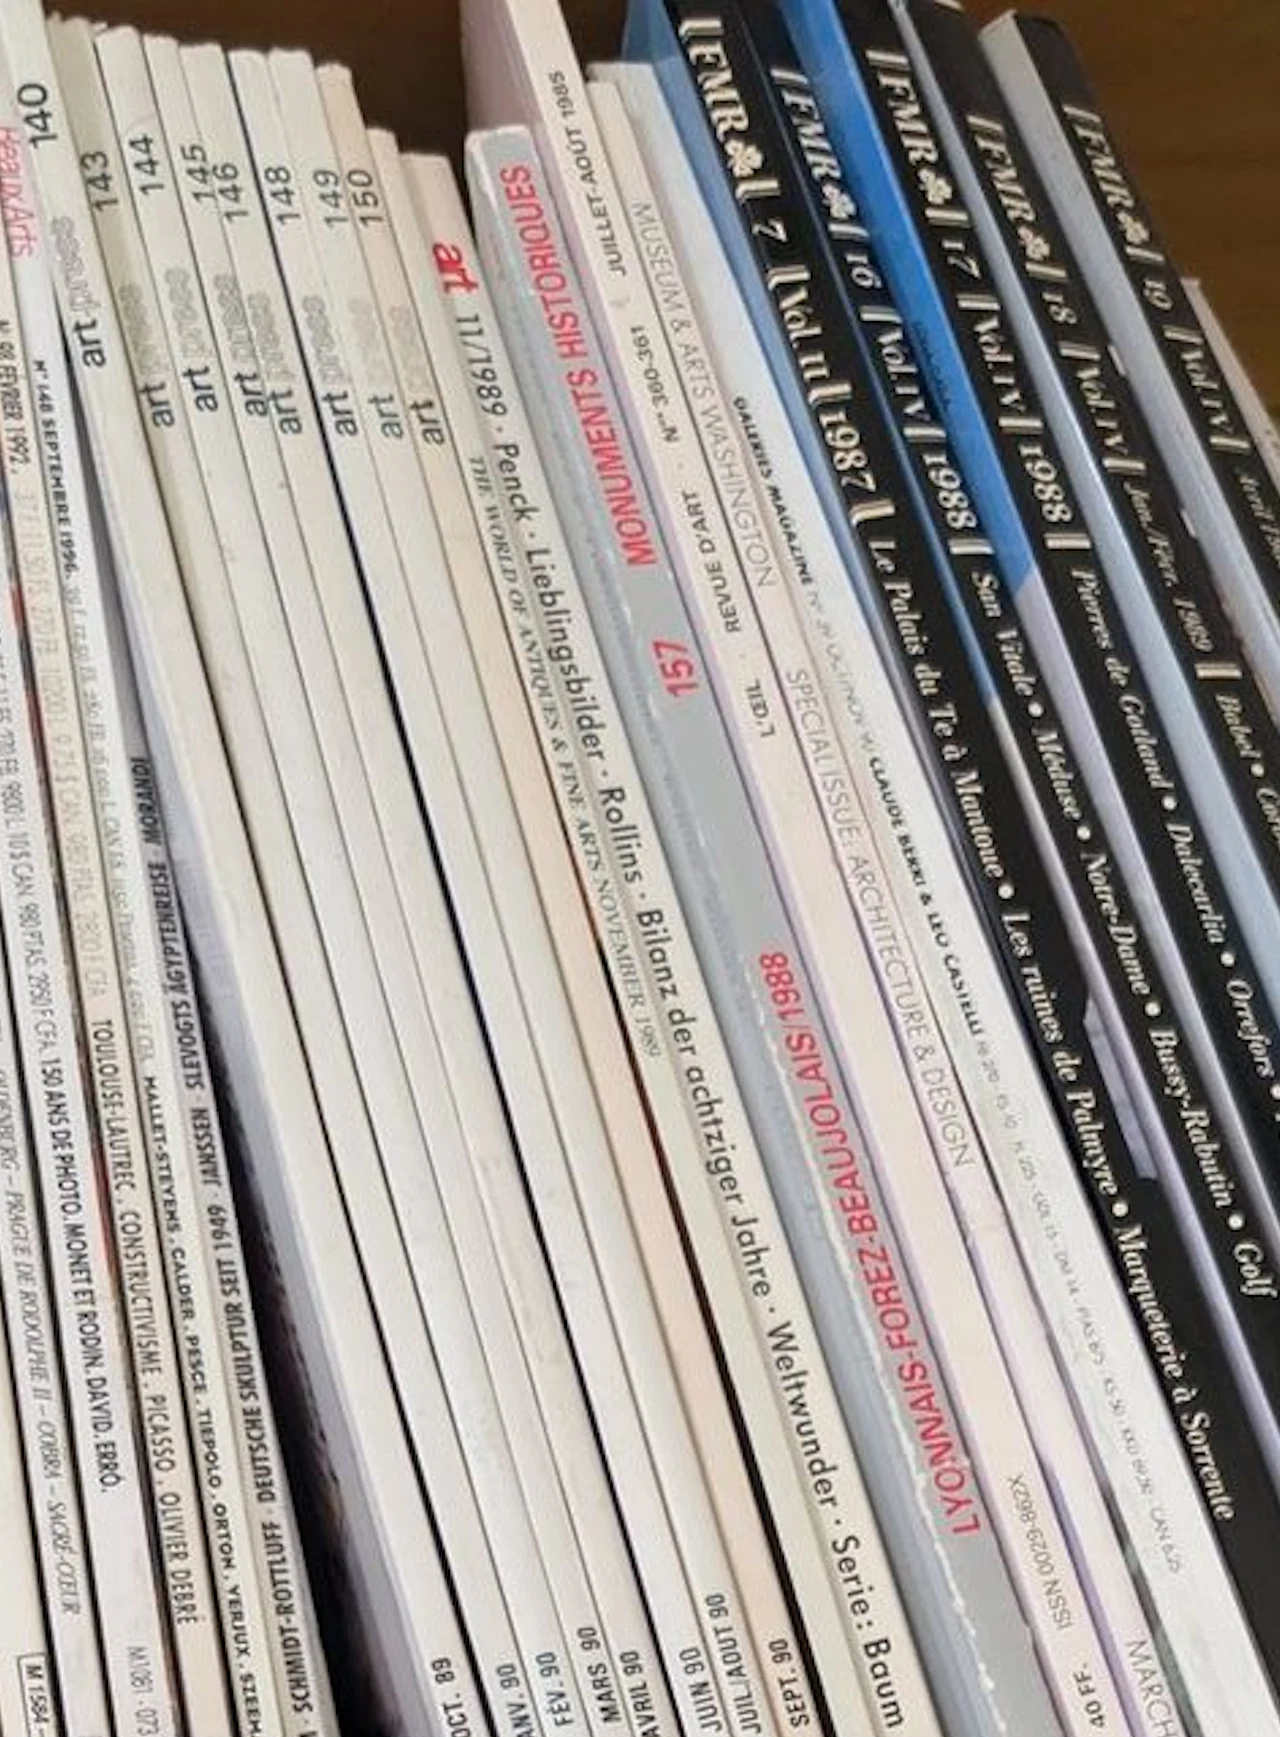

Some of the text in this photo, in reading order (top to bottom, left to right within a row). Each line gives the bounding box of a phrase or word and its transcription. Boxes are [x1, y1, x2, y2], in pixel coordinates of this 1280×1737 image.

[15, 82, 58, 149] 140
[689, 41, 750, 142] FMR
[80, 150, 118, 212] 143
[127, 133, 164, 195] 144
[263, 165, 301, 225] 148
[345, 168, 383, 226] 150
[72, 318, 106, 367] art
[778, 286, 822, 349] Vol.
[498, 164, 656, 566] MONUMENTS HISTORIQUES
[320, 390, 358, 436] art
[818, 410, 876, 491] 1987
[867, 540, 896, 572] Le
[882, 581, 928, 655] Palais
[651, 639, 699, 698] 157
[913, 662, 941, 696] du
[950, 770, 1004, 878] Mantoue
[1070, 569, 1112, 649] Pierres
[1104, 656, 1130, 686] de
[1119, 693, 1175, 788] Gotland
[1225, 978, 1275, 1076] Orrefors
[1000, 912, 1033, 957] Les
[430, 241, 904, 1729] art 11/1989 Penck Lieblingsbilder Rollins Bilanz der achtziger Jahre Weltwunder Serie: Baum
[1020, 965, 1063, 1043] ruines
[1051, 1050, 1081, 1081] de
[1065, 1088, 1118, 1195] Palmyre
[1115, 1224, 1186, 1380] Marqueterie
[1179, 1410, 1235, 1522] Sorrente
